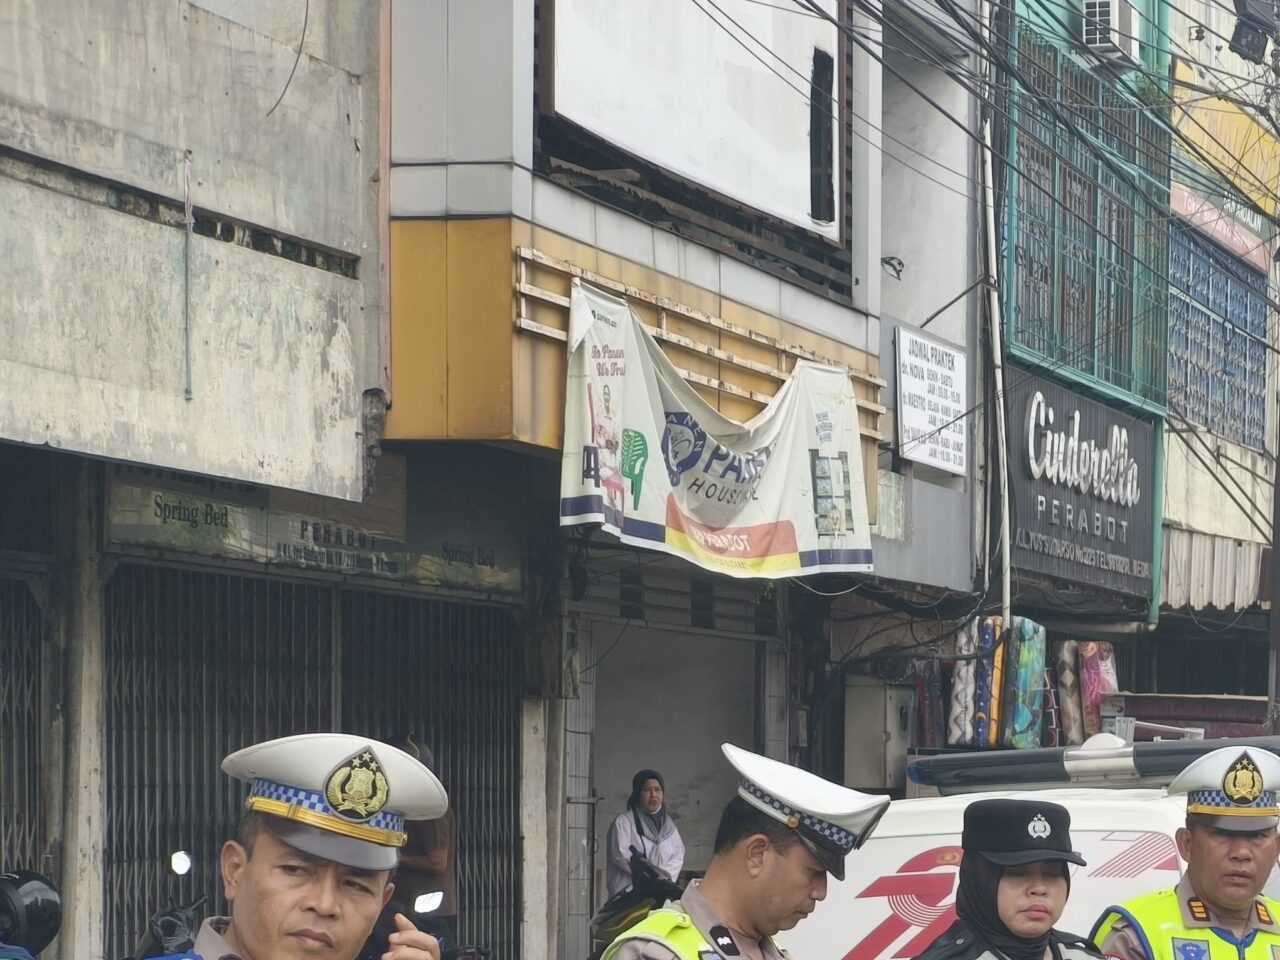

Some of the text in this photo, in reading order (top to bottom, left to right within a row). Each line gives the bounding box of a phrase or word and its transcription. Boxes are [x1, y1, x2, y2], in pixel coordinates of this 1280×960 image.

[1028, 391, 1141, 508] Cinderella
[153, 494, 229, 529] Spring Bed
[1037, 495, 1129, 544] PERABOT
